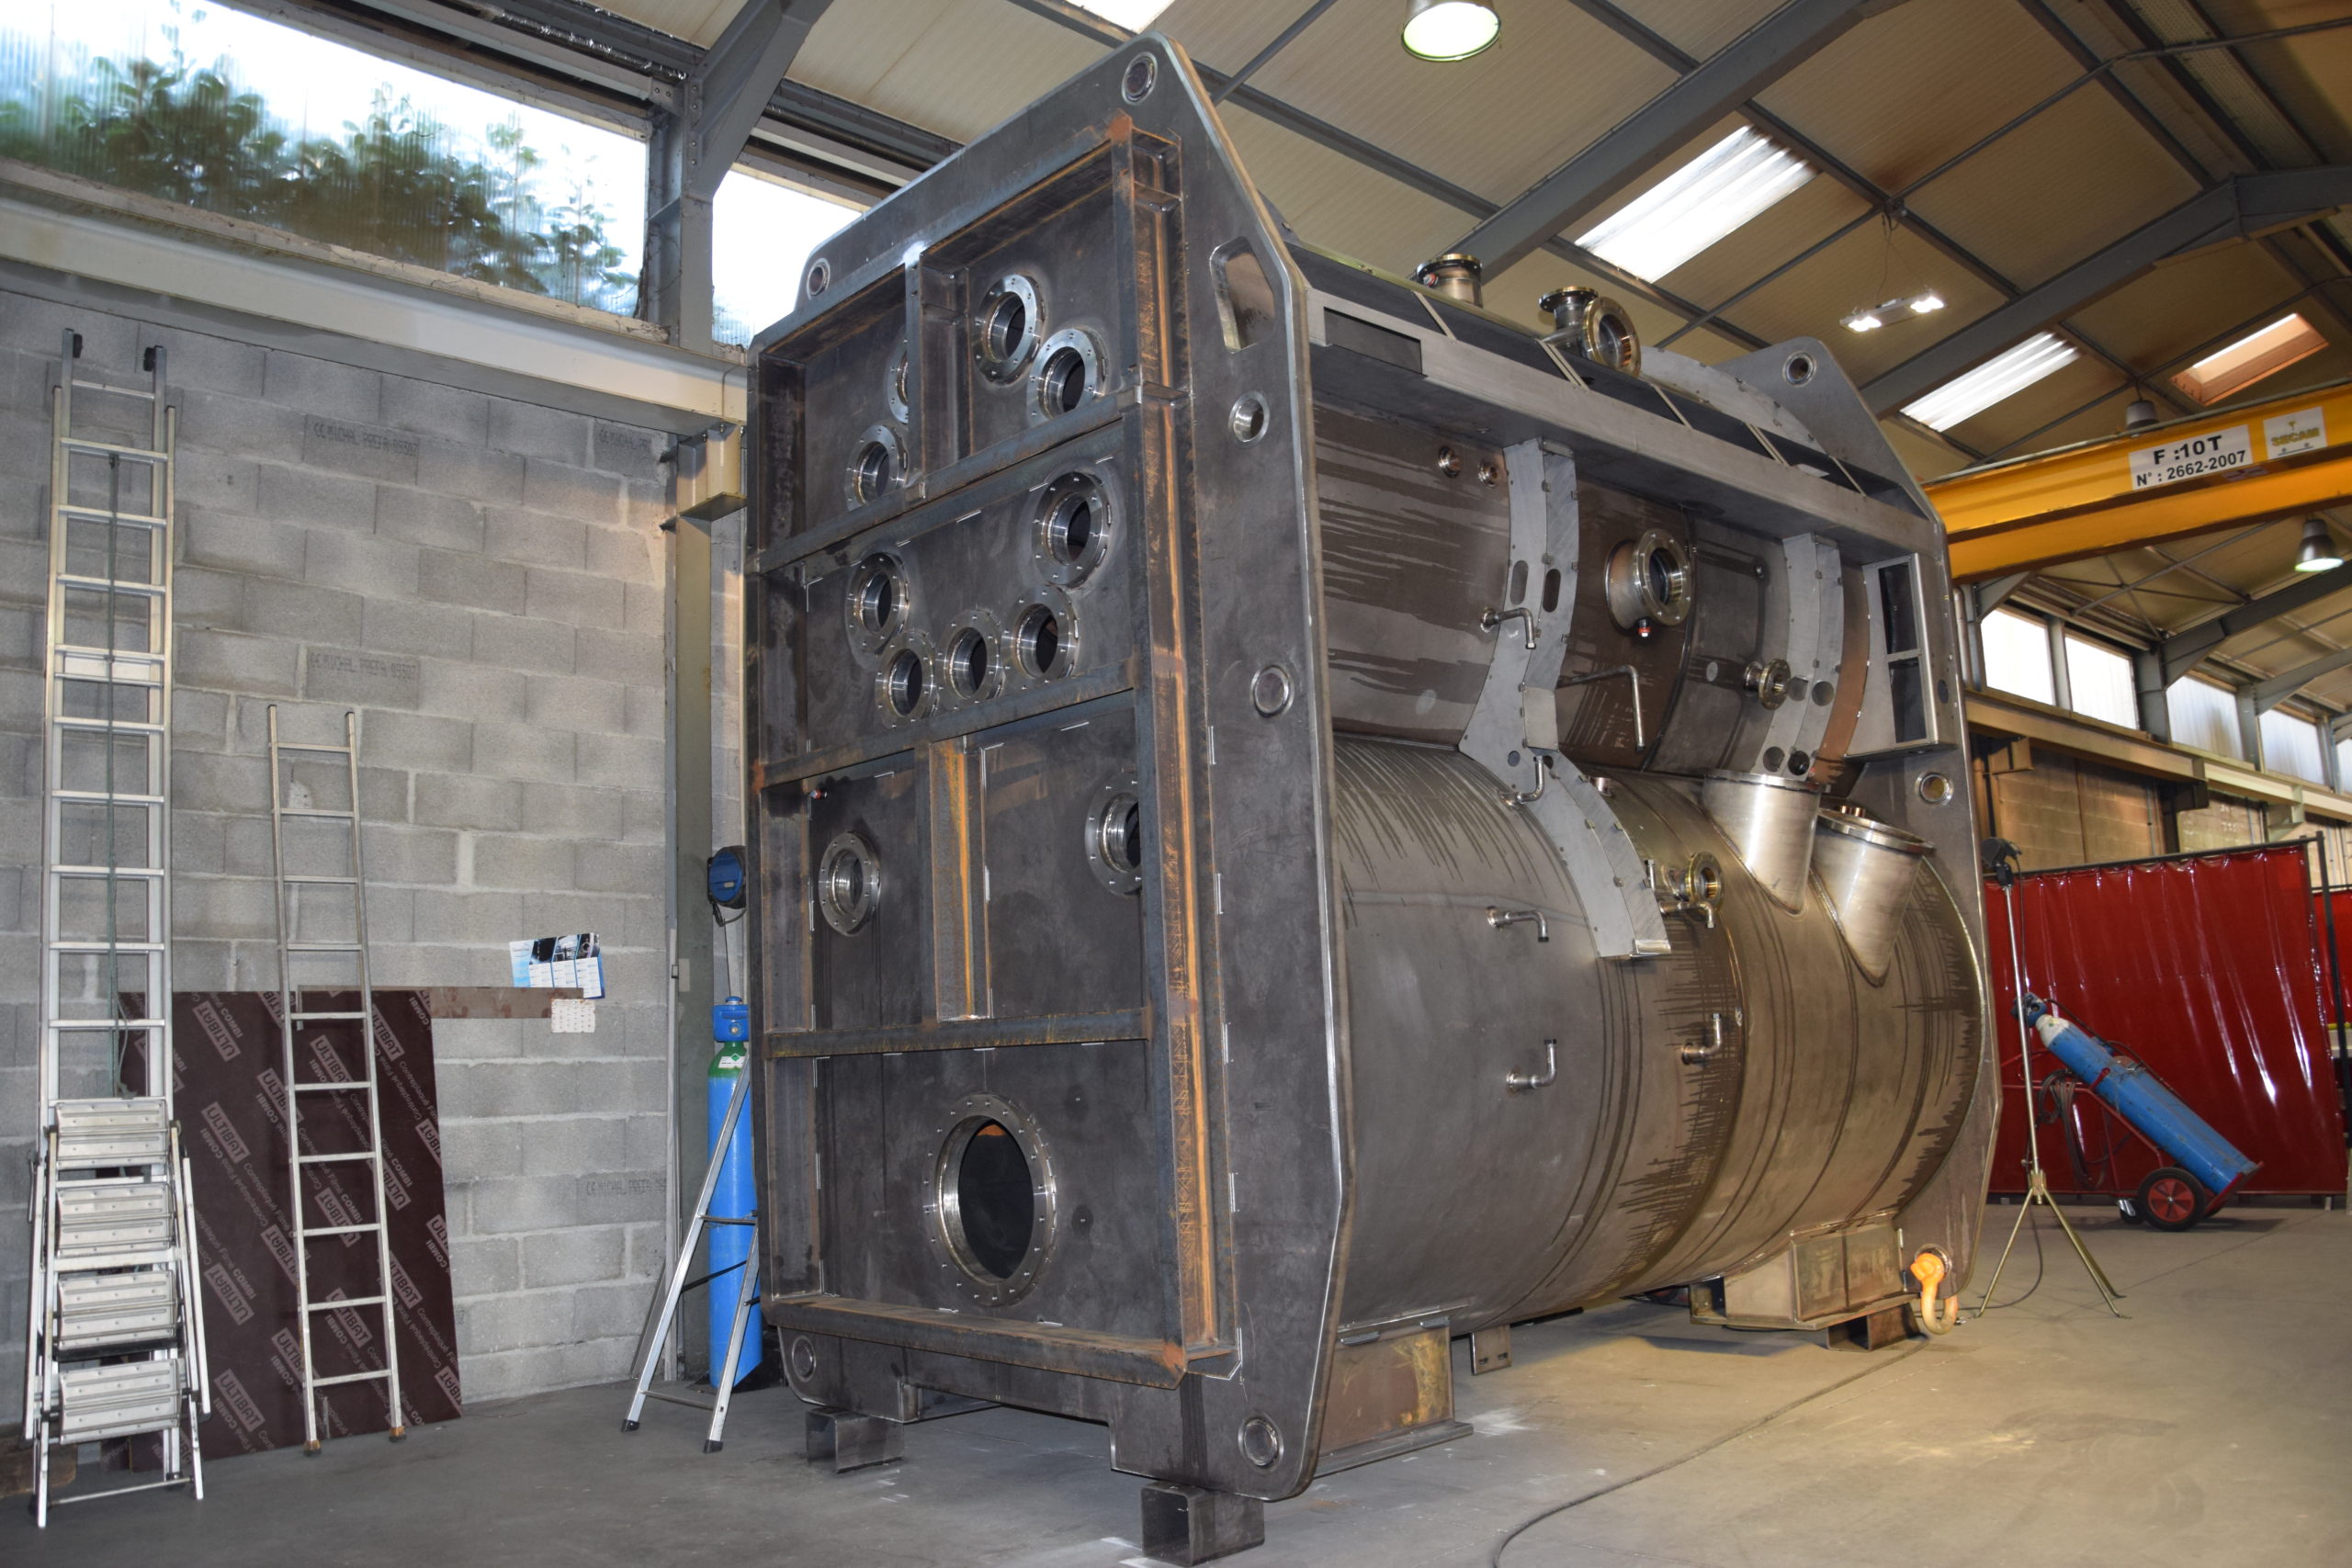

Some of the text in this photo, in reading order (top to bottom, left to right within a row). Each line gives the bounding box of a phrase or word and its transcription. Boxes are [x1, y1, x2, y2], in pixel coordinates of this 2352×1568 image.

[2166, 450, 2245, 480] 2662-2007
[220, 1008, 243, 1037] COMBI
[408, 997, 429, 1025] COMBI
[198, 1004, 235, 1056] ULTIBAT
[309, 1059, 326, 1082] OMBI
[255, 1092, 278, 1122] COMBI
[314, 1040, 347, 1086] ULTIBA
[390, 1157, 412, 1187] COMBI
[200, 1128, 223, 1158] COMBI
[207, 1106, 244, 1158] ULTIBAT
[243, 1162, 277, 1211] Contreplaqué
[340, 1193, 362, 1223] COMBI
[425, 1239, 447, 1268] COMBI
[209, 1268, 249, 1321] ULTIBAT
[232, 1268, 255, 1299] COMBI
[324, 1314, 347, 1344] COMBI
[271, 1355, 294, 1385] COMBI
[212, 1396, 237, 1429] COMBI
[219, 1372, 260, 1427] ULTIBAT
